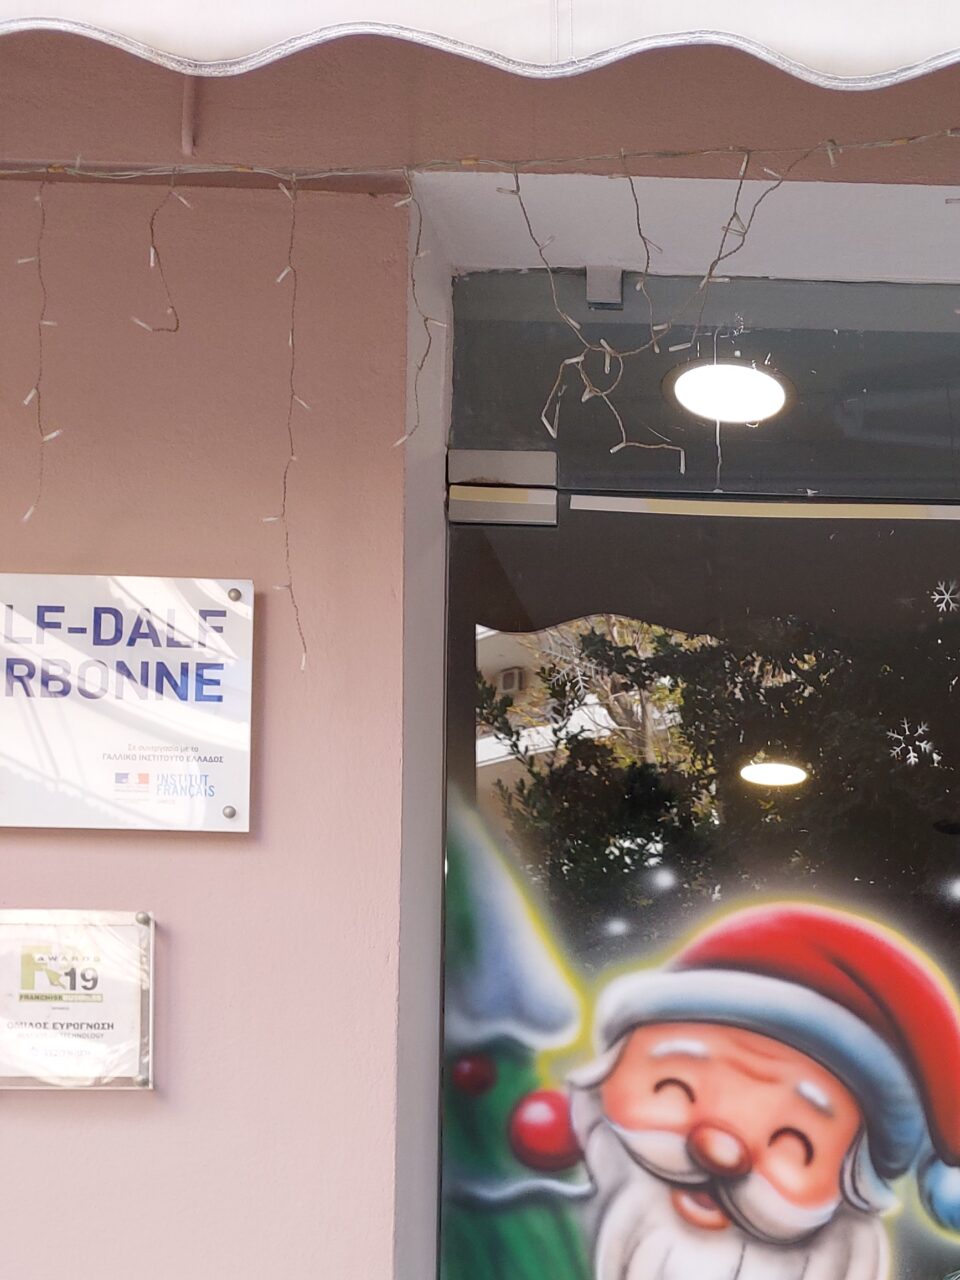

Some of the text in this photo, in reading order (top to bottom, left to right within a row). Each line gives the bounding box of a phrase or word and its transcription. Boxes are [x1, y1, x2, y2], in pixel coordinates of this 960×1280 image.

[4, 657, 225, 702] RBONNE
[102, 753, 224, 763] ΓΑΛΛΙΚΟ ΙΝΣΤΙΤΟΥΤΟ ΕΛΛΑΔΟΣ
[156, 774, 209, 785] INSTITUT
